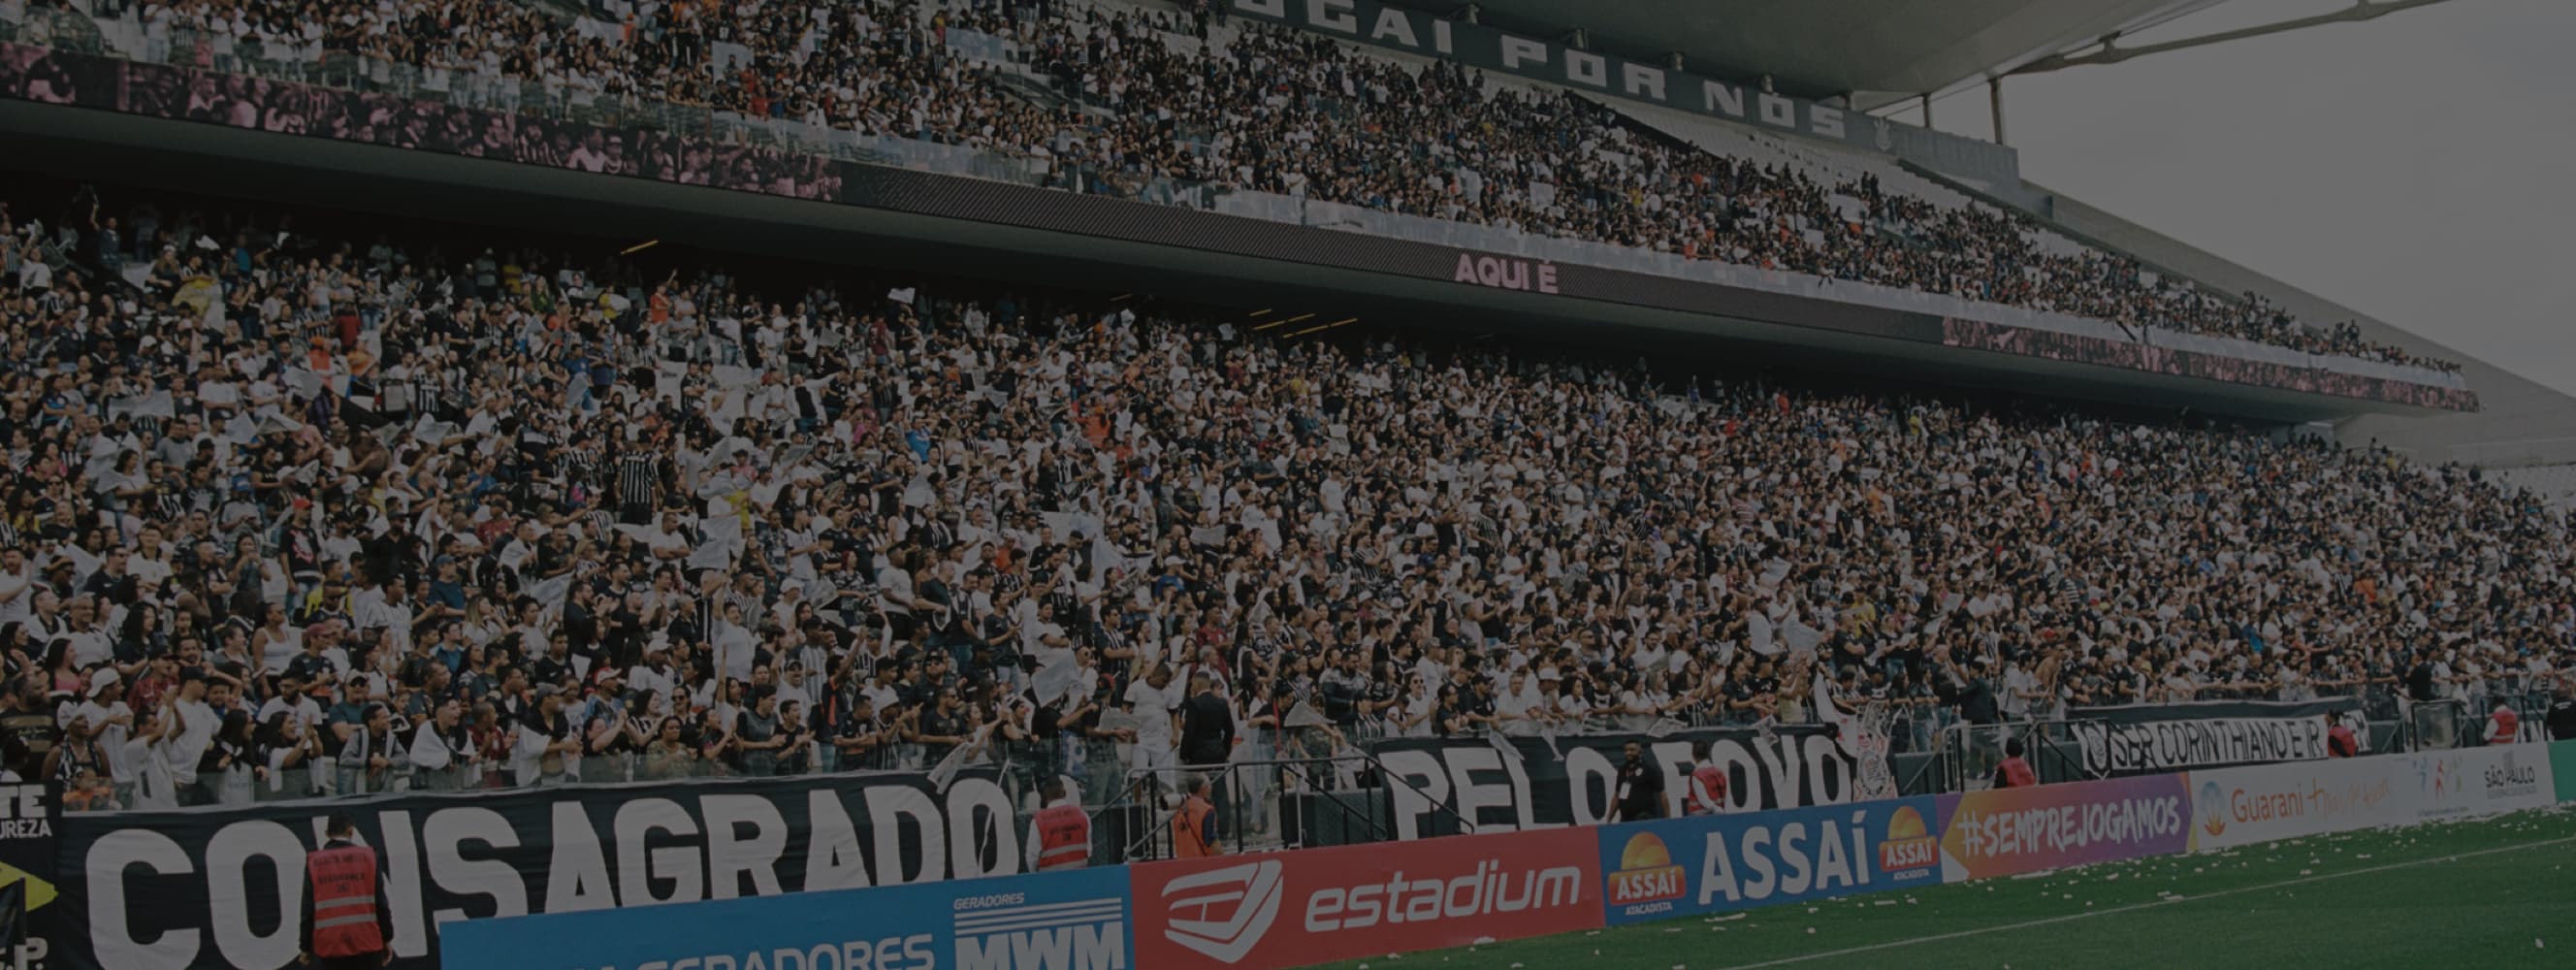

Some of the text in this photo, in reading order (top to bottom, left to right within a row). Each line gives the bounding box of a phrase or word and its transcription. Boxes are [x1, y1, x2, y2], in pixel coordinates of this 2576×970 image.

[1500, 34, 1666, 100] POR
[1703, 78, 1846, 139] NÓS
[1455, 252, 1560, 295] AQUI É
[2504, 765, 2536, 786] PAULO
[2231, 782, 2305, 824] Guarani
[1955, 795, 2181, 858] #SEMPREJOGAMOS
[85, 777, 1019, 970] CONSAGRADO
[1699, 809, 1871, 906] ASSAÍ
[1885, 839, 1933, 867] ASSAÍ
[953, 891, 1026, 910] GERADORES
[1304, 858, 1582, 933] estadium
[1616, 869, 1678, 902] ASSAÍ
[954, 921, 1126, 970] MWM
